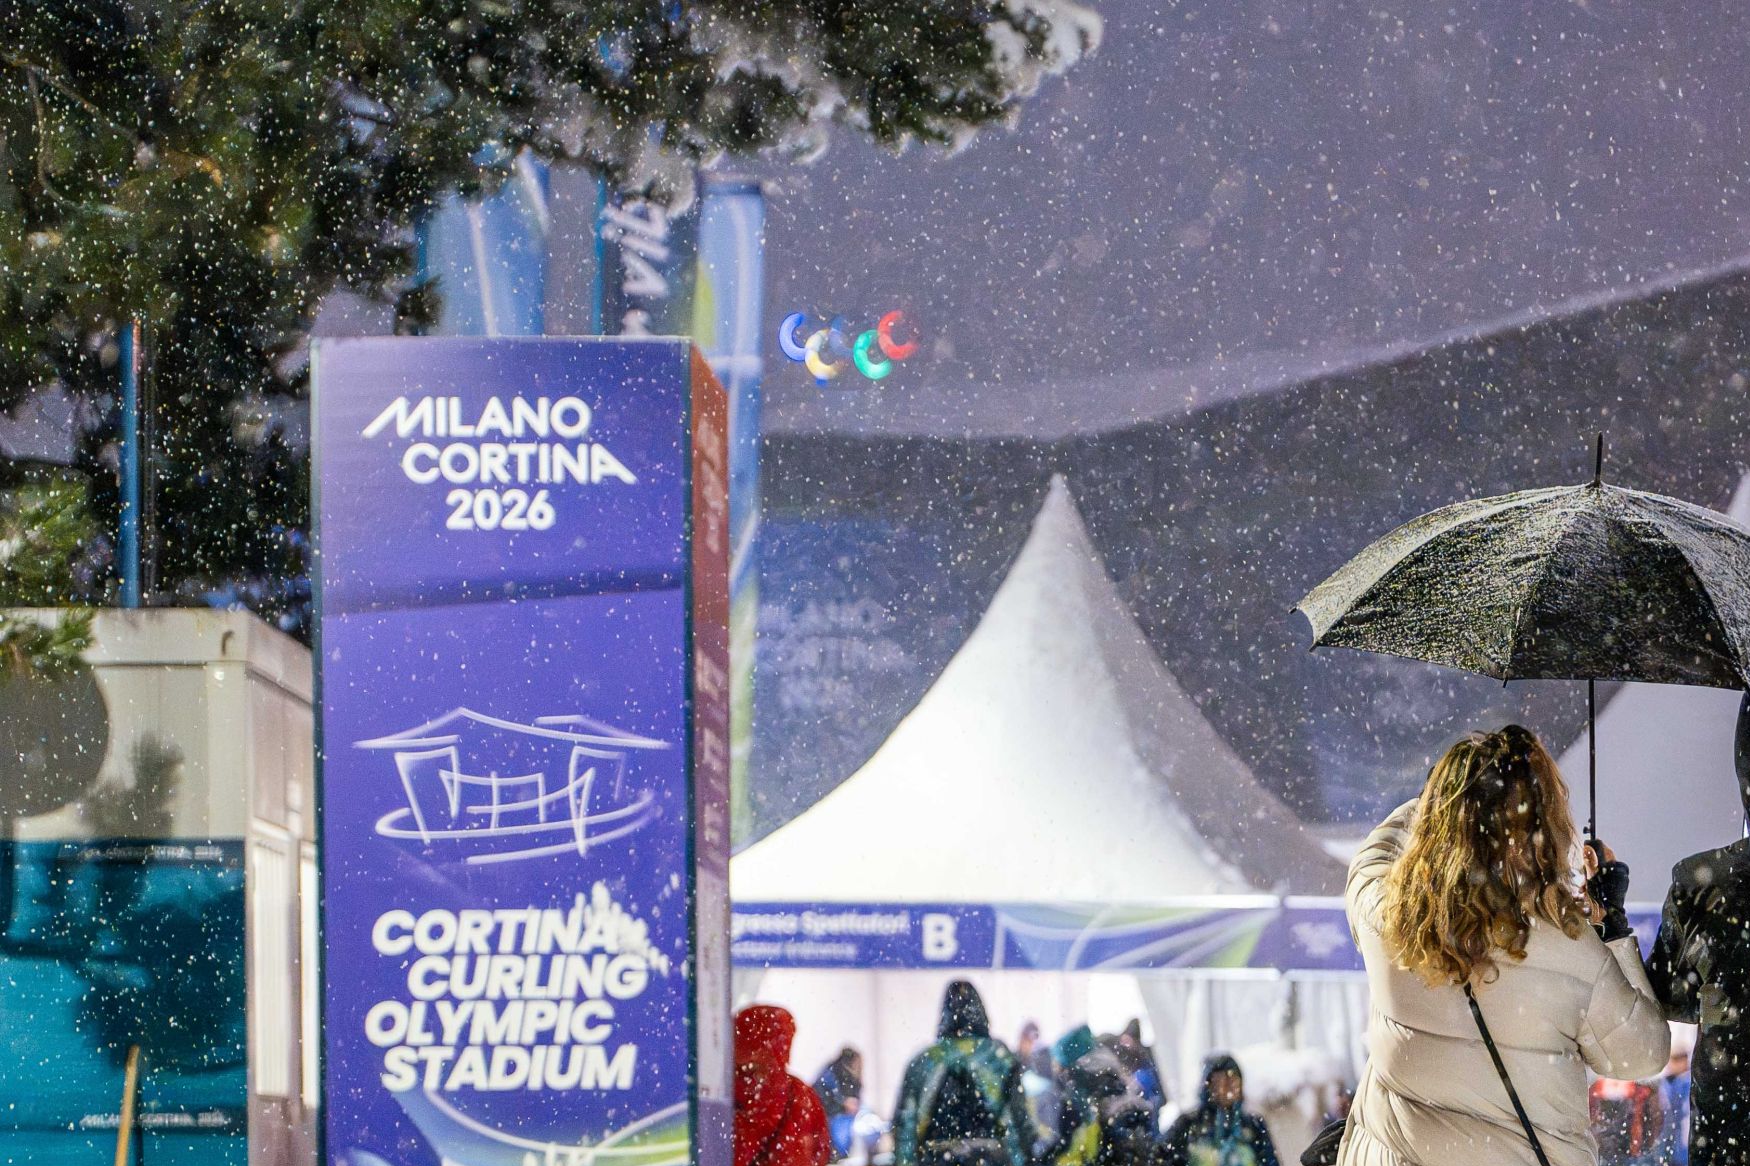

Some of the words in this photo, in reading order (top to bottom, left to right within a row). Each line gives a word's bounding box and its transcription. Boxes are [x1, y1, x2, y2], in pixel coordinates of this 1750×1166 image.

[361, 396, 592, 439] MILANO
[401, 442, 638, 485] CORTINA
[445, 489, 556, 530] 2026
[372, 908, 622, 956] CORTINA
[922, 912, 958, 962] B
[406, 953, 649, 1001] CURLING
[364, 1000, 616, 1048] OLYMPIC
[381, 1044, 639, 1092] STADIUM
